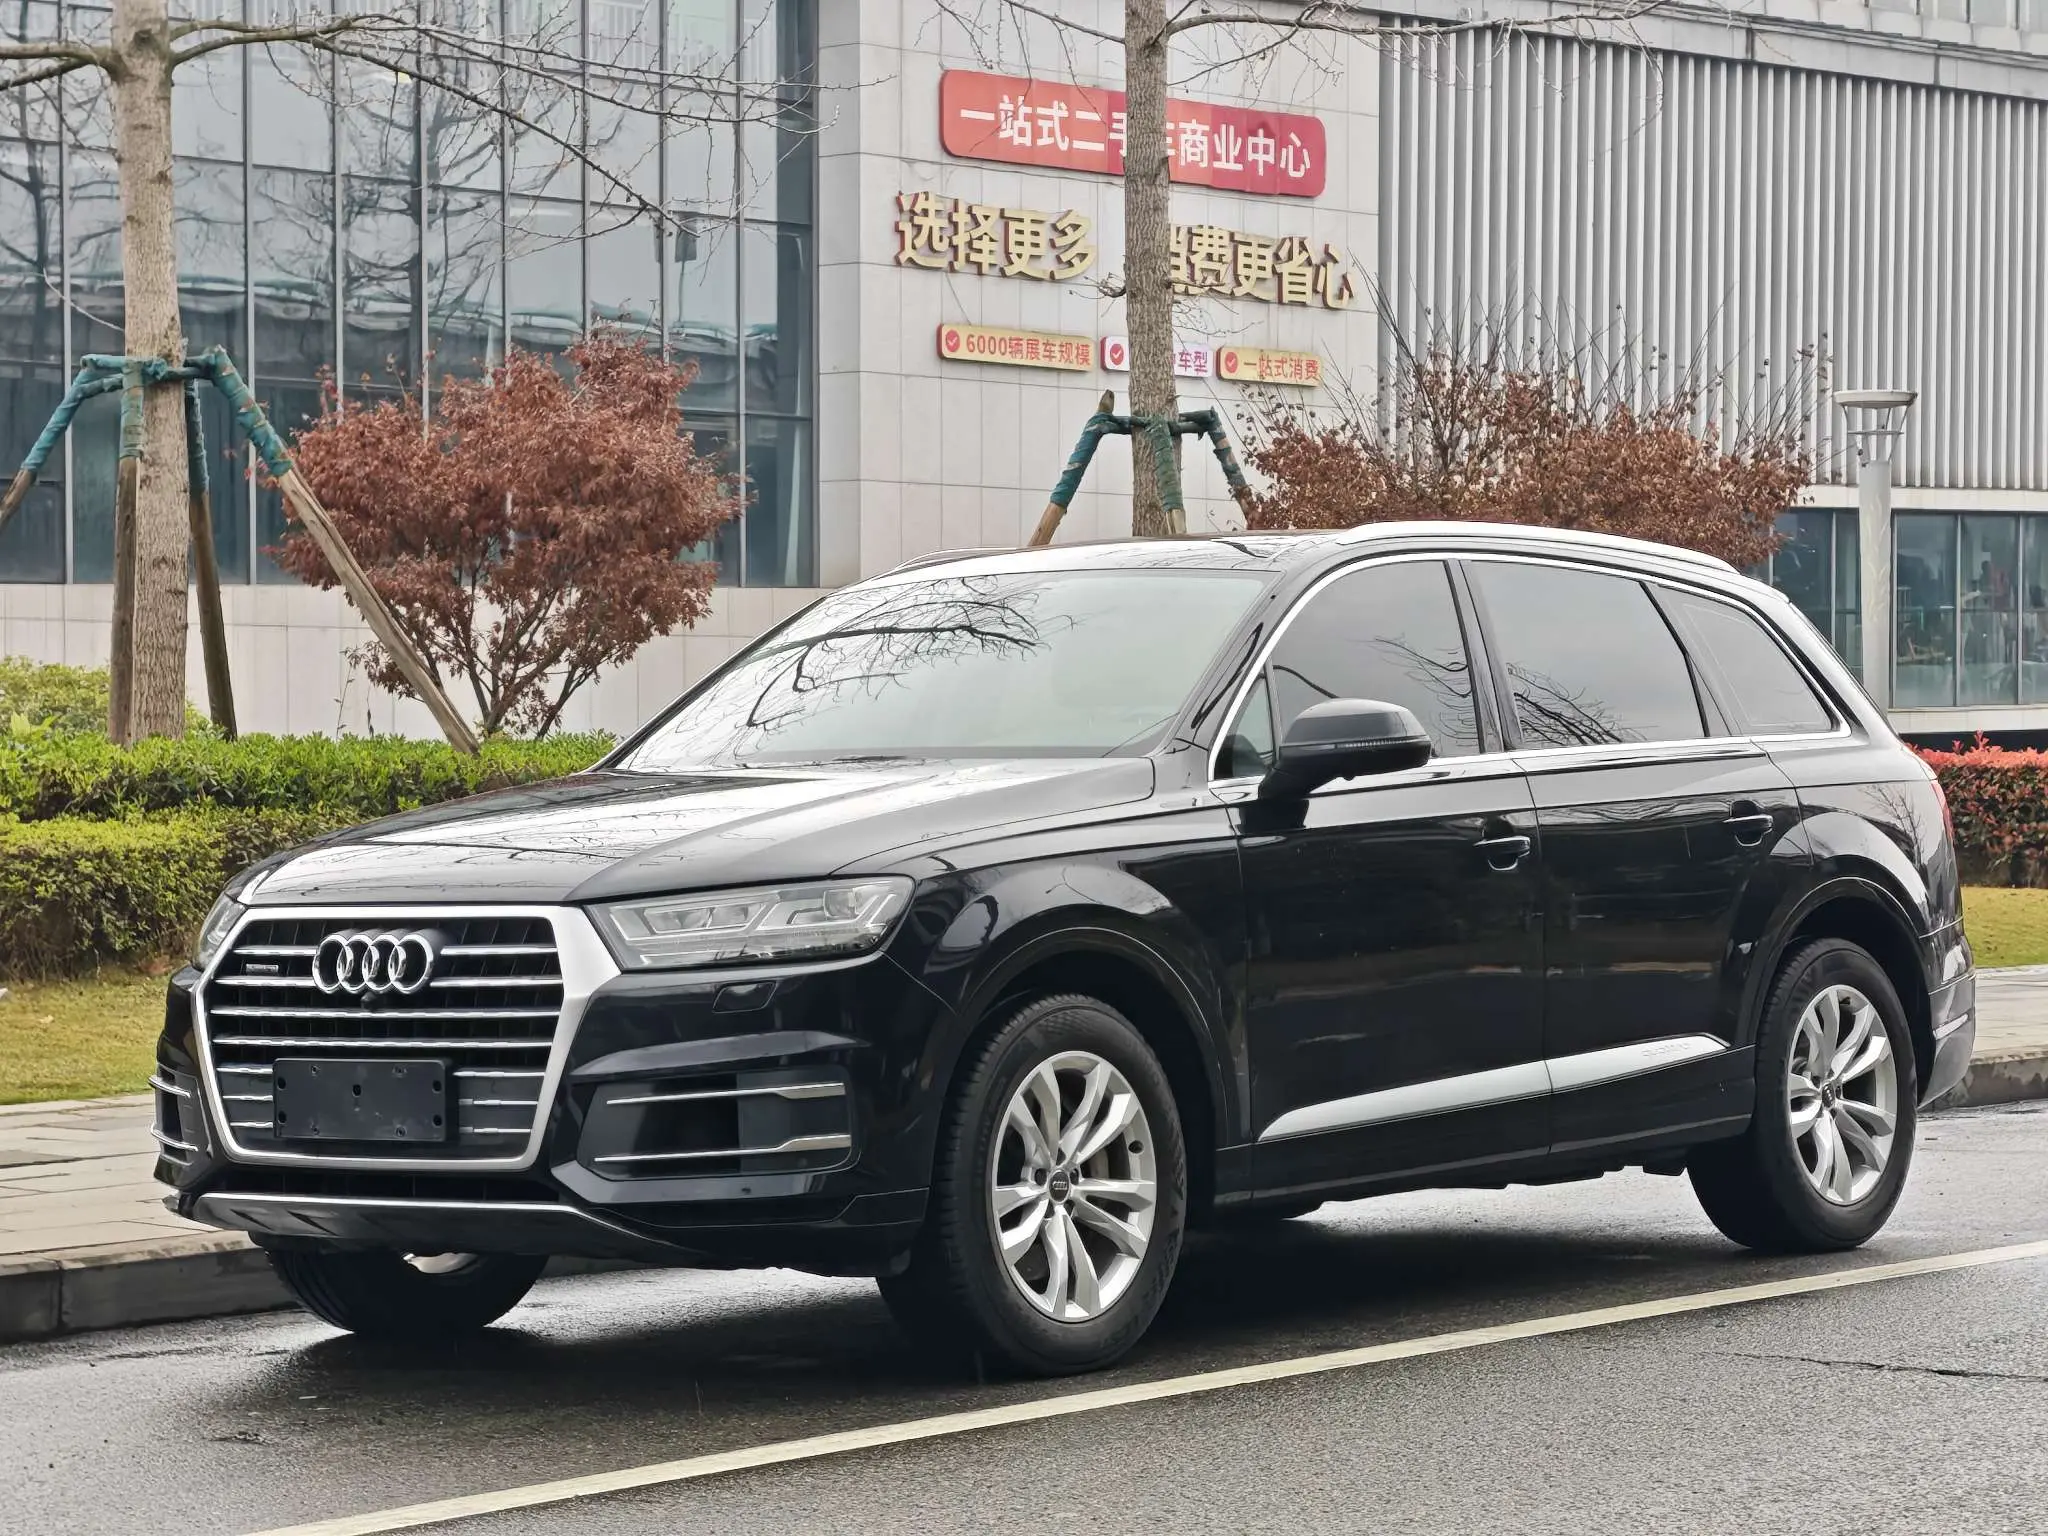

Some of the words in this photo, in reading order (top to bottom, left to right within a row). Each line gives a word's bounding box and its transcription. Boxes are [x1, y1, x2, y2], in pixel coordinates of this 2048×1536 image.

[960, 95, 1311, 178] 一站式二手商业中心
[895, 191, 1097, 280] 选择更多
[966, 334, 1091, 366] 6000辆展车规模
[1243, 354, 1320, 381] 一站式消费
